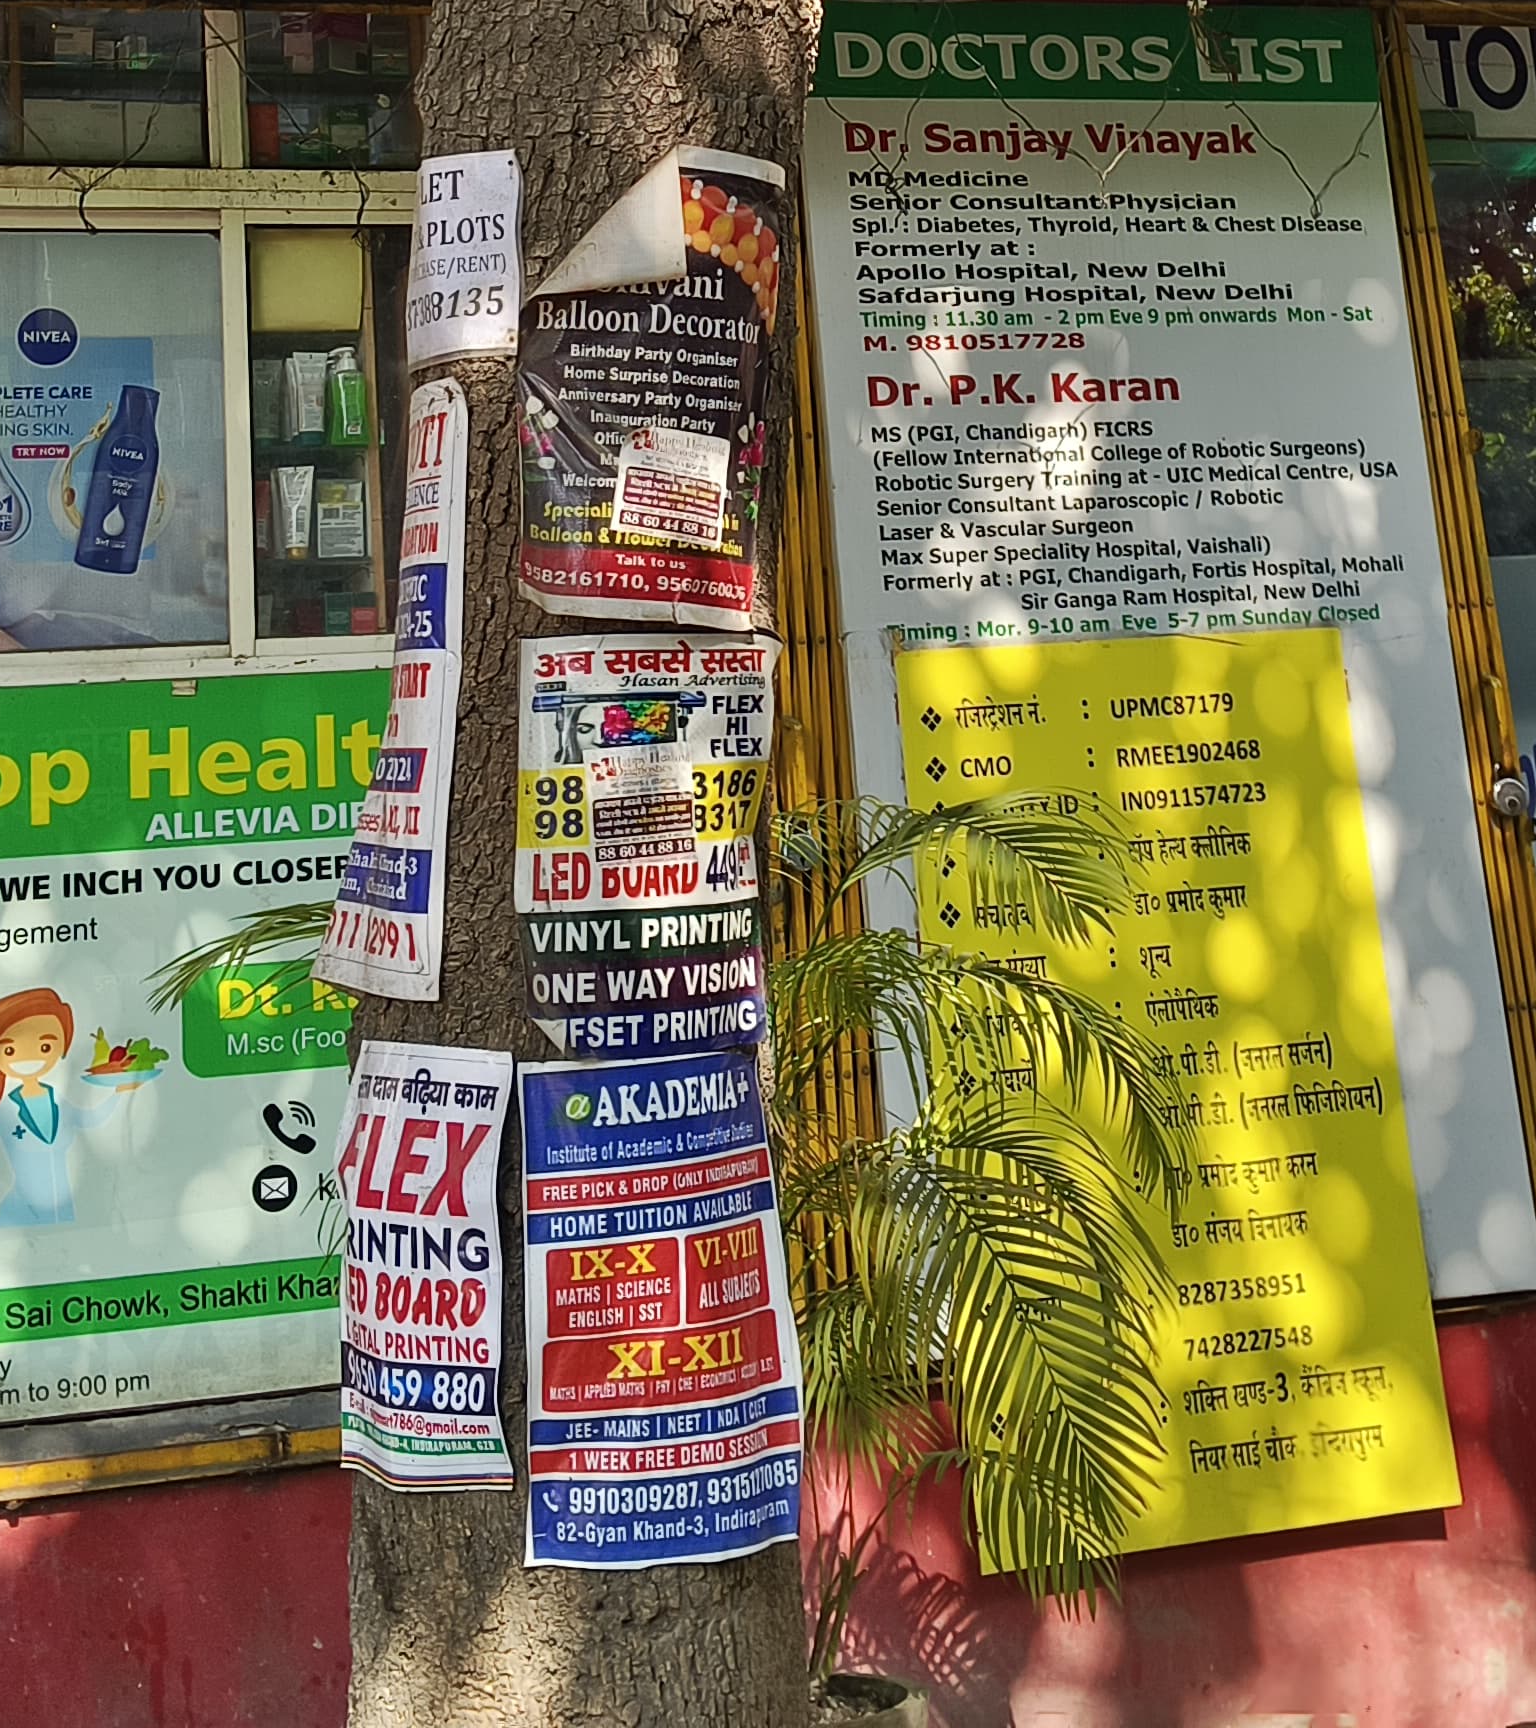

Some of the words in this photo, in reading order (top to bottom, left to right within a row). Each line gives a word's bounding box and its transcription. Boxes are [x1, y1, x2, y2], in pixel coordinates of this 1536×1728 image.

[833, 31, 1174, 84] DOCTORS
[1196, 36, 1342, 84] LIST
[844, 122, 909, 154] Dr.
[924, 123, 1073, 160] Sanjay
[1084, 122, 1257, 160] Vinayak
[904, 170, 1029, 188] Medicine
[850, 192, 942, 212] Senior
[949, 192, 1104, 211] Consultant
[1108, 192, 1236, 213] Physician
[425, 213, 506, 246] PLOTS
[854, 240, 984, 261] Formerly
[858, 285, 1015, 308] Safdarjung
[1024, 284, 1147, 305] Hospital,
[1156, 284, 1218, 302] New
[1224, 282, 1294, 300] Delhi
[23, 331, 72, 343] NIVEA
[536, 299, 640, 334] Balloon
[648, 302, 761, 345] Decorator
[864, 335, 898, 352] M.
[906, 332, 1086, 352] 9810517728
[48, 386, 93, 400] CARE
[868, 375, 933, 407] Dr.
[948, 374, 1036, 404] P.K.
[1052, 370, 1181, 403] Karan
[34, 423, 74, 437] SKIN.
[874, 448, 948, 472] (Fellow
[953, 445, 1085, 467] International
[1090, 442, 1163, 465] College
[1192, 439, 1265, 460] Robotic
[1270, 438, 1366, 460] Surgeons)
[880, 546, 924, 566] Max
[928, 546, 985, 568] Super
[992, 540, 1090, 564] Speciality
[1096, 537, 1182, 560] Hospital,
[1187, 535, 1272, 556] Vaishali)
[534, 650, 595, 678] अब
[604, 640, 694, 675] सबसे
[700, 649, 766, 675] सस्ता
[712, 695, 763, 715] FLEX
[1109, 692, 1235, 721] UPMC87179
[727, 717, 748, 737] HI
[127, 713, 380, 802] Healt
[711, 738, 762, 758] FLEX
[959, 755, 1013, 779] CMO
[1116, 739, 1262, 768] RMEE1902468
[1121, 782, 1267, 811] IN0911574723
[532, 852, 591, 902] LED
[529, 919, 631, 954] VINYL
[641, 908, 753, 949] PRINTING
[532, 972, 597, 1005] ONE
[607, 967, 675, 1002] WAY
[681, 956, 757, 997] VISION
[550, 1212, 608, 1239] HOME
[613, 1205, 687, 1231] TUITION
[693, 1190, 754, 1225] AVAILABLE
[570, 1244, 658, 1281] IX-X
[3, 1300, 55, 1333] Sai
[61, 1289, 171, 1327] Chowk,
[179, 1274, 269, 1312] Shakti
[374, 1274, 487, 1330] BOARD
[1178, 1272, 1306, 1307] 8287358951
[606, 1326, 744, 1381] XI-XII
[1183, 1325, 1314, 1360] 7428227548
[569, 1481, 703, 1514] 9910309287,
